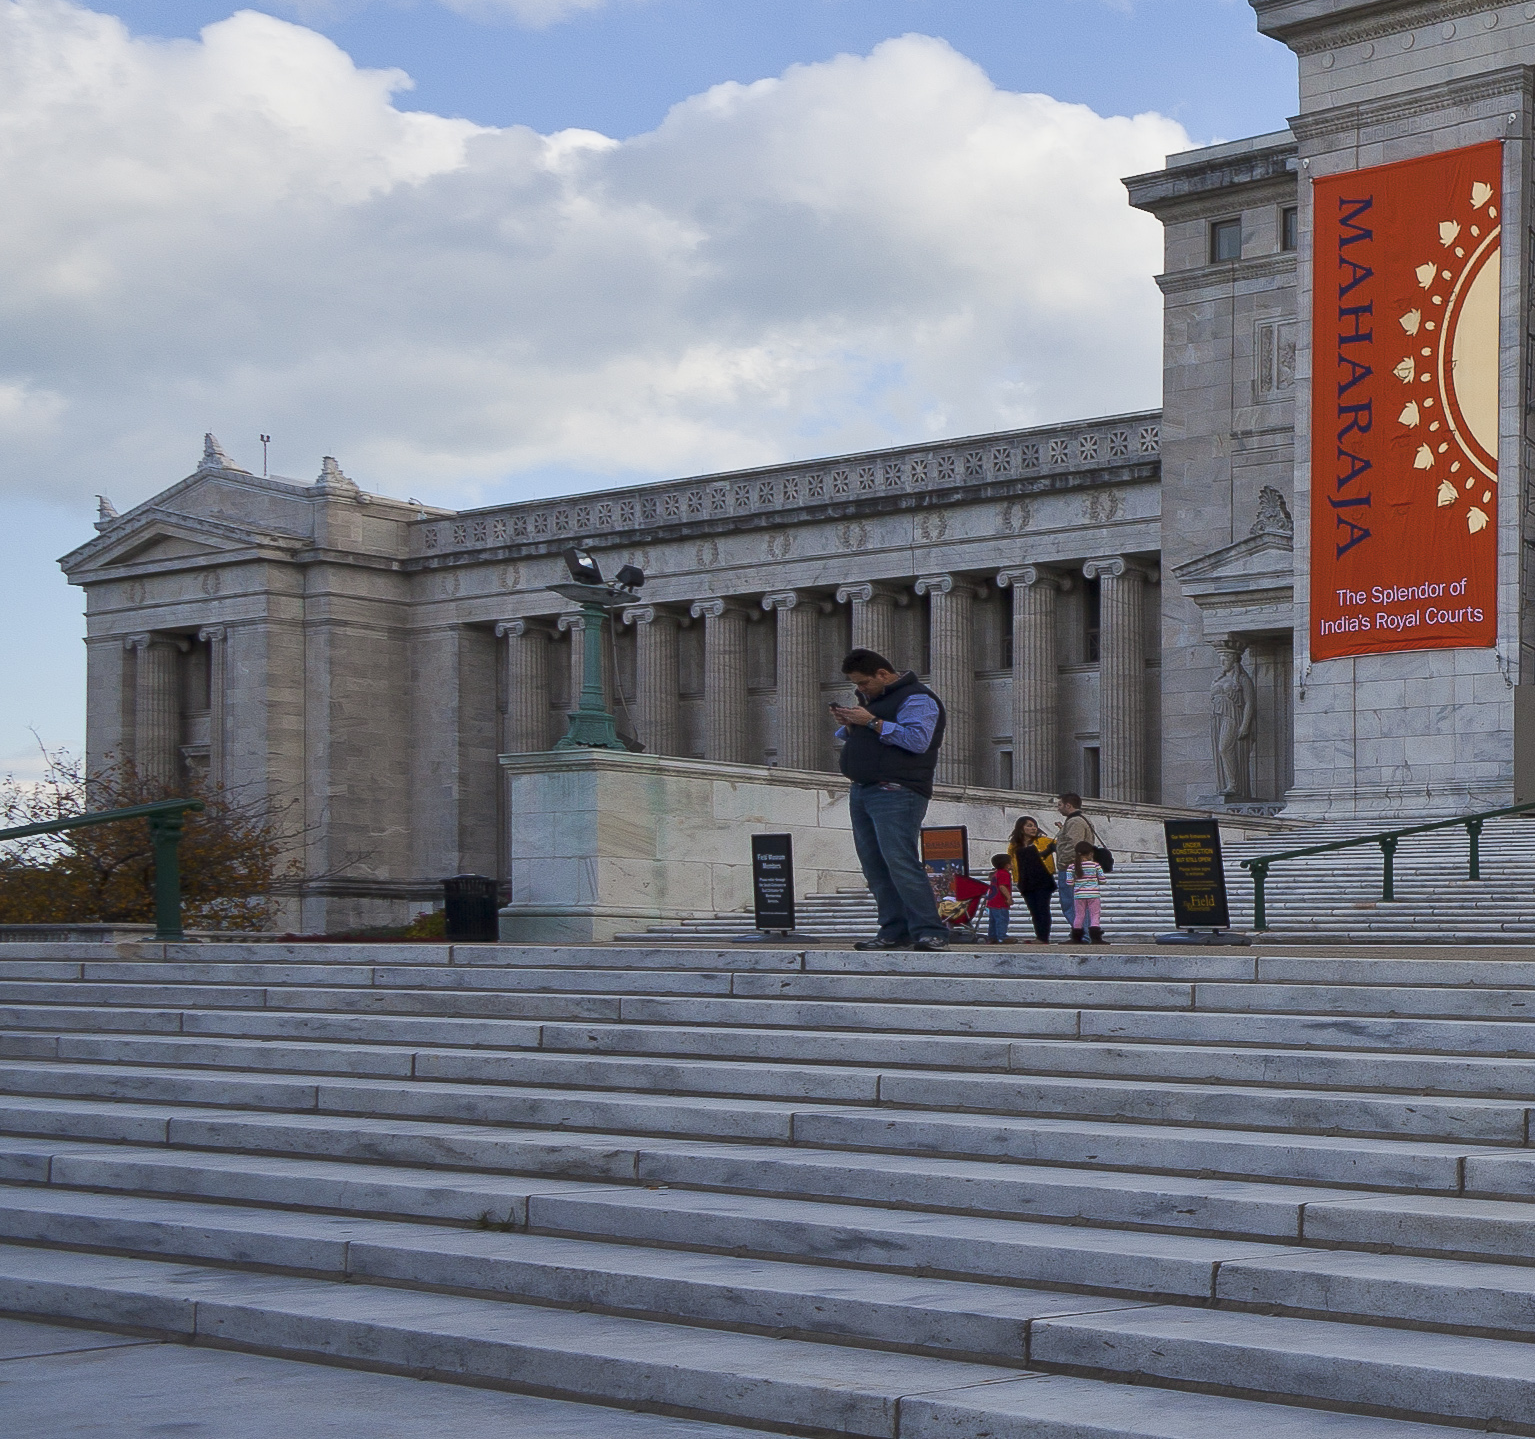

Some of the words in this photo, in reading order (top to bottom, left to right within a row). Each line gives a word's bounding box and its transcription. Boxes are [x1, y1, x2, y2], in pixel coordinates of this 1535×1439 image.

[1328, 194, 1374, 561] MAHARAJA
[1336, 589, 1367, 607] The
[1371, 581, 1447, 606] Splendor
[1449, 577, 1468, 596] of
[1320, 614, 1371, 636] India's
[1375, 609, 1420, 632] Royal
[1425, 605, 1485, 625] Courts
[1190, 895, 1215, 906] Field
